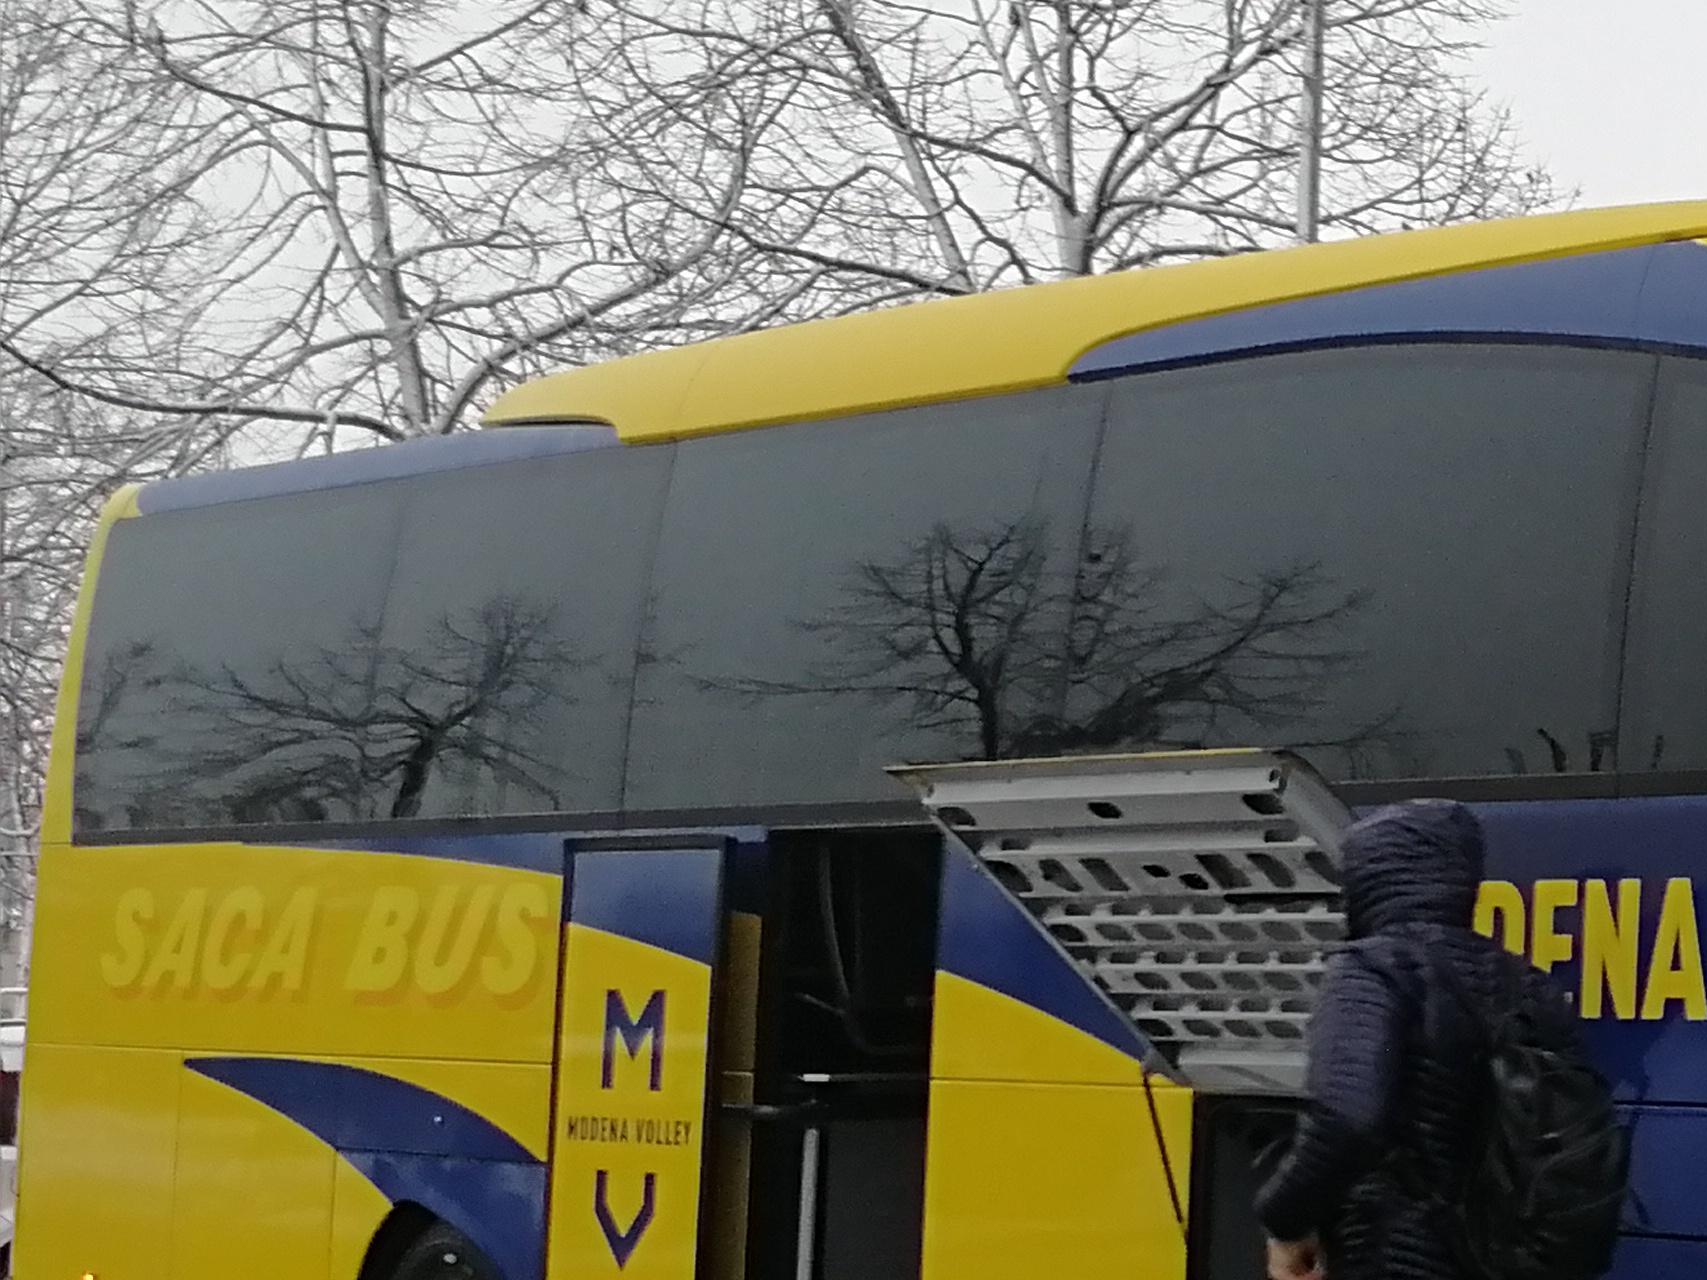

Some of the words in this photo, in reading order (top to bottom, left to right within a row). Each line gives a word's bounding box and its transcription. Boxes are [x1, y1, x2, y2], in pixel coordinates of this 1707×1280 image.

[100, 884, 322, 1000] SACA
[343, 882, 551, 1006] BUS
[601, 989, 666, 1092] M
[566, 1116, 629, 1143] MODENA
[635, 1120, 692, 1147] VOLLEY
[594, 1169, 657, 1270] V
